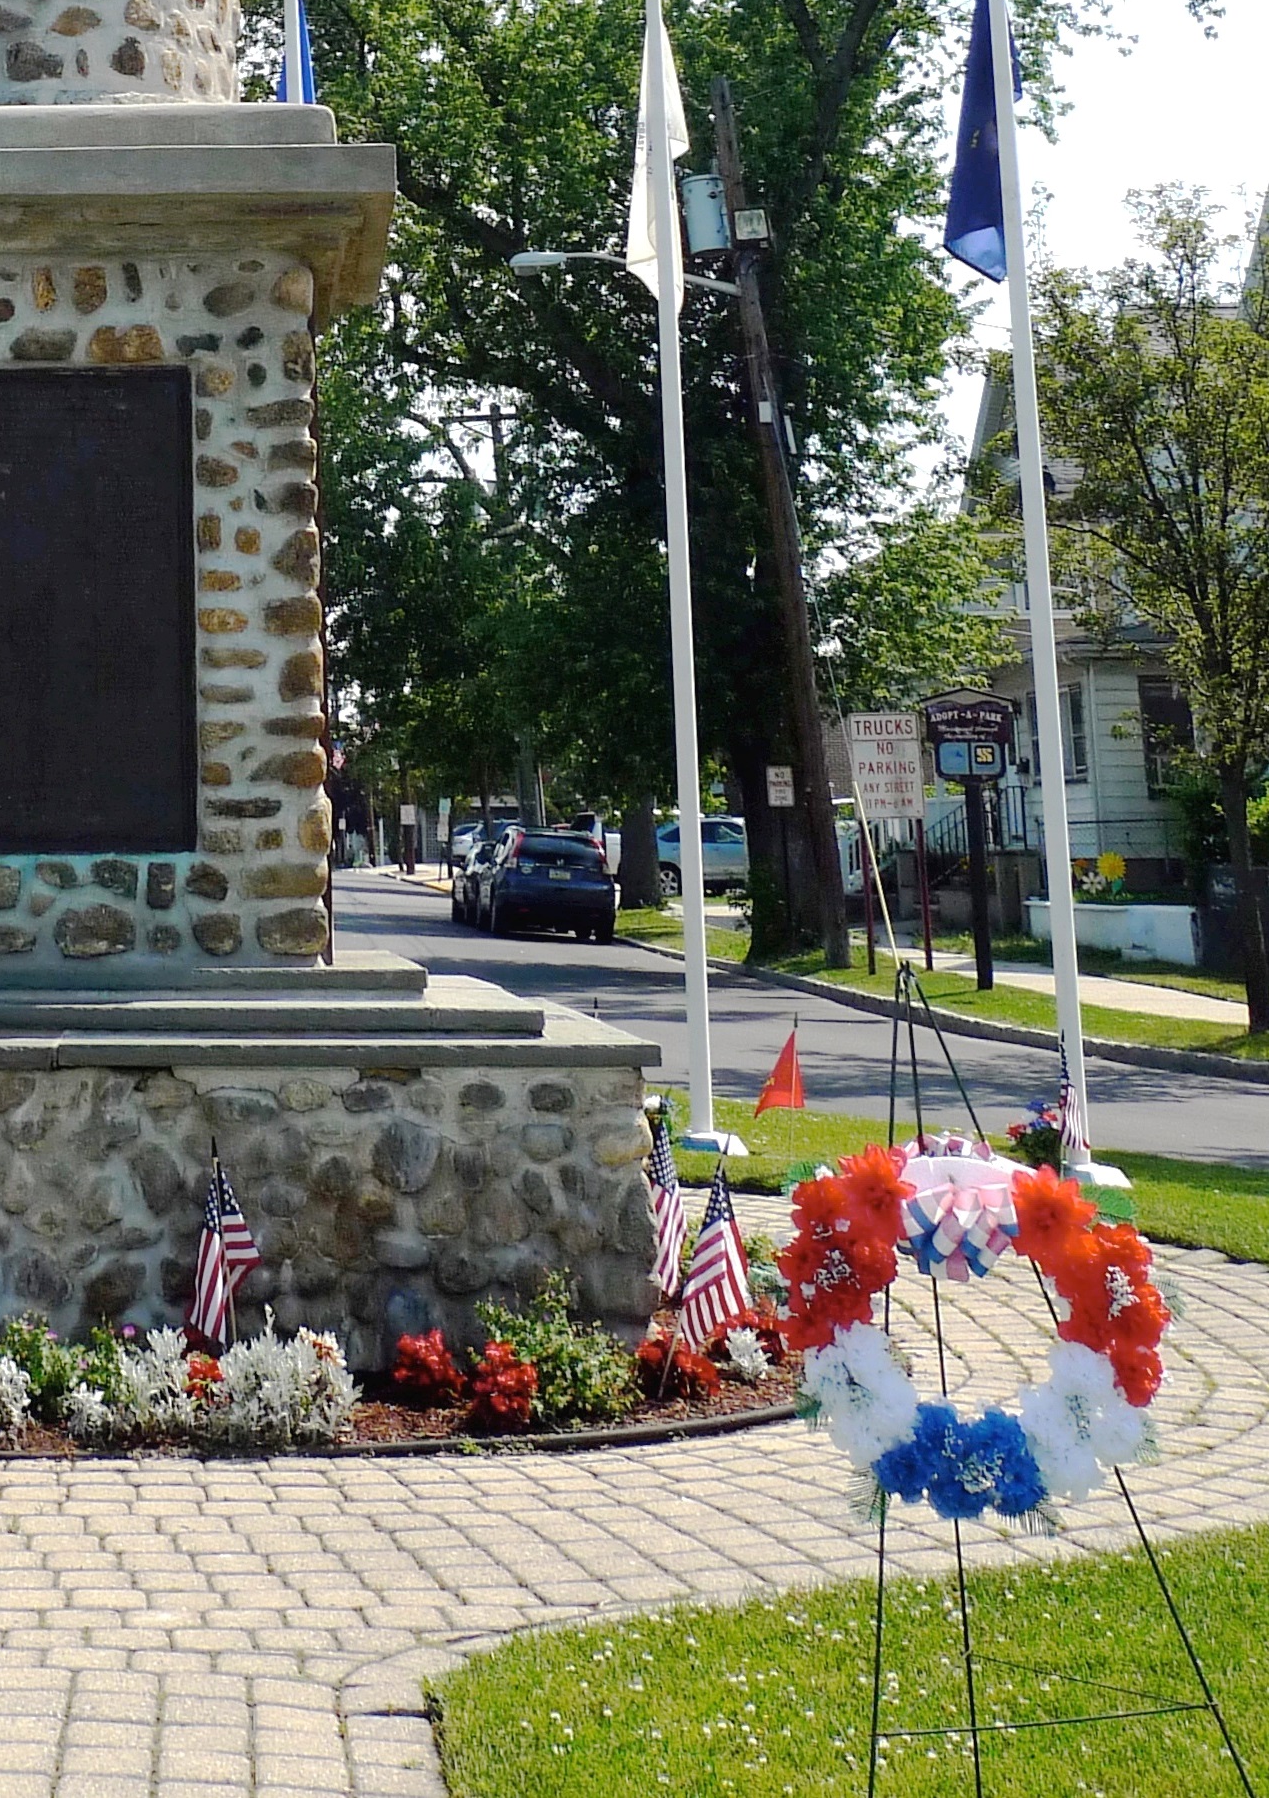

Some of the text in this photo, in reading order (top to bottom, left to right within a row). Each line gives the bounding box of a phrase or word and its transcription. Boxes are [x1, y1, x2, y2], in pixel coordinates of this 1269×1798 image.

[930, 710, 959, 722] ADOPT
[979, 711, 1002, 722] PARK
[854, 720, 913, 735] TRUCKS
[876, 741, 894, 755] NO
[858, 761, 916, 775] PARKING
[862, 781, 914, 793] ANY STREET
